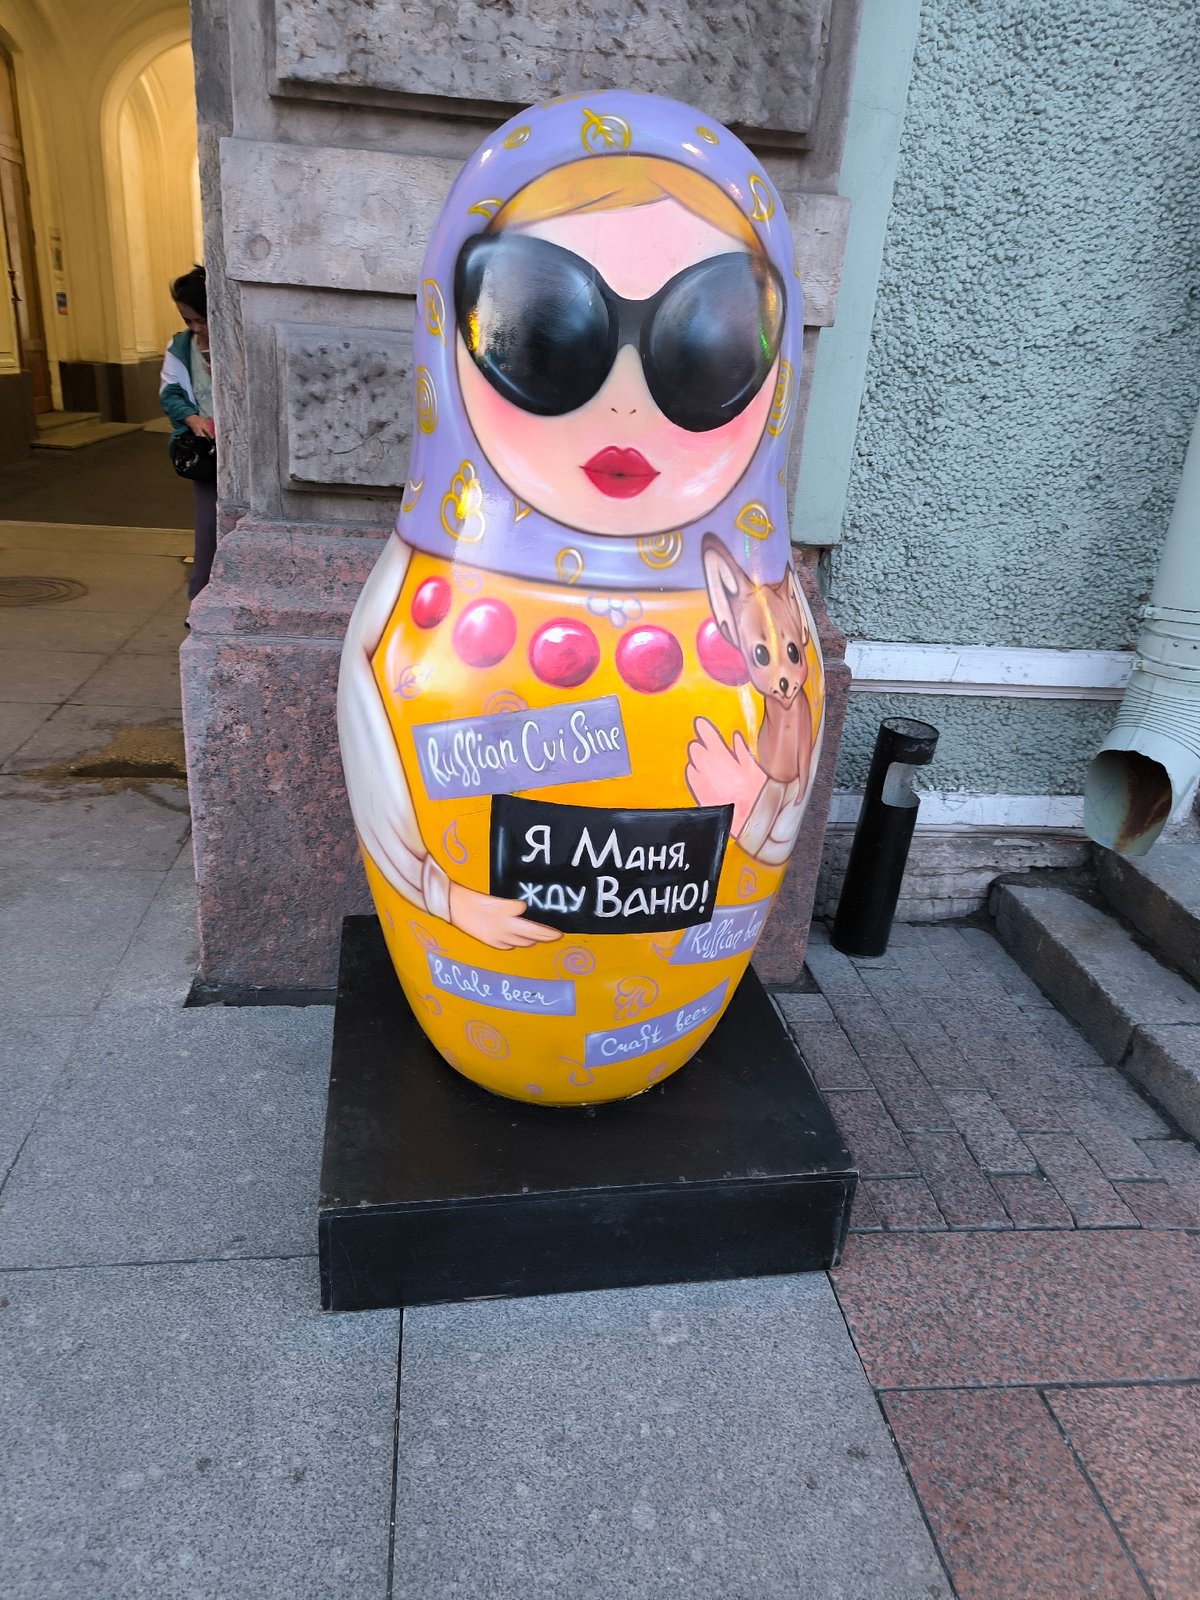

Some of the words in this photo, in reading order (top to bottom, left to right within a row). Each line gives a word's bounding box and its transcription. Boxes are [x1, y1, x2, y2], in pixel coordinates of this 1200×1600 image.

[521, 825, 551, 865] Я
[571, 827, 690, 871] Маня,
[594, 876, 709, 918] Ваню!
[601, 1024, 663, 1057] Craft
